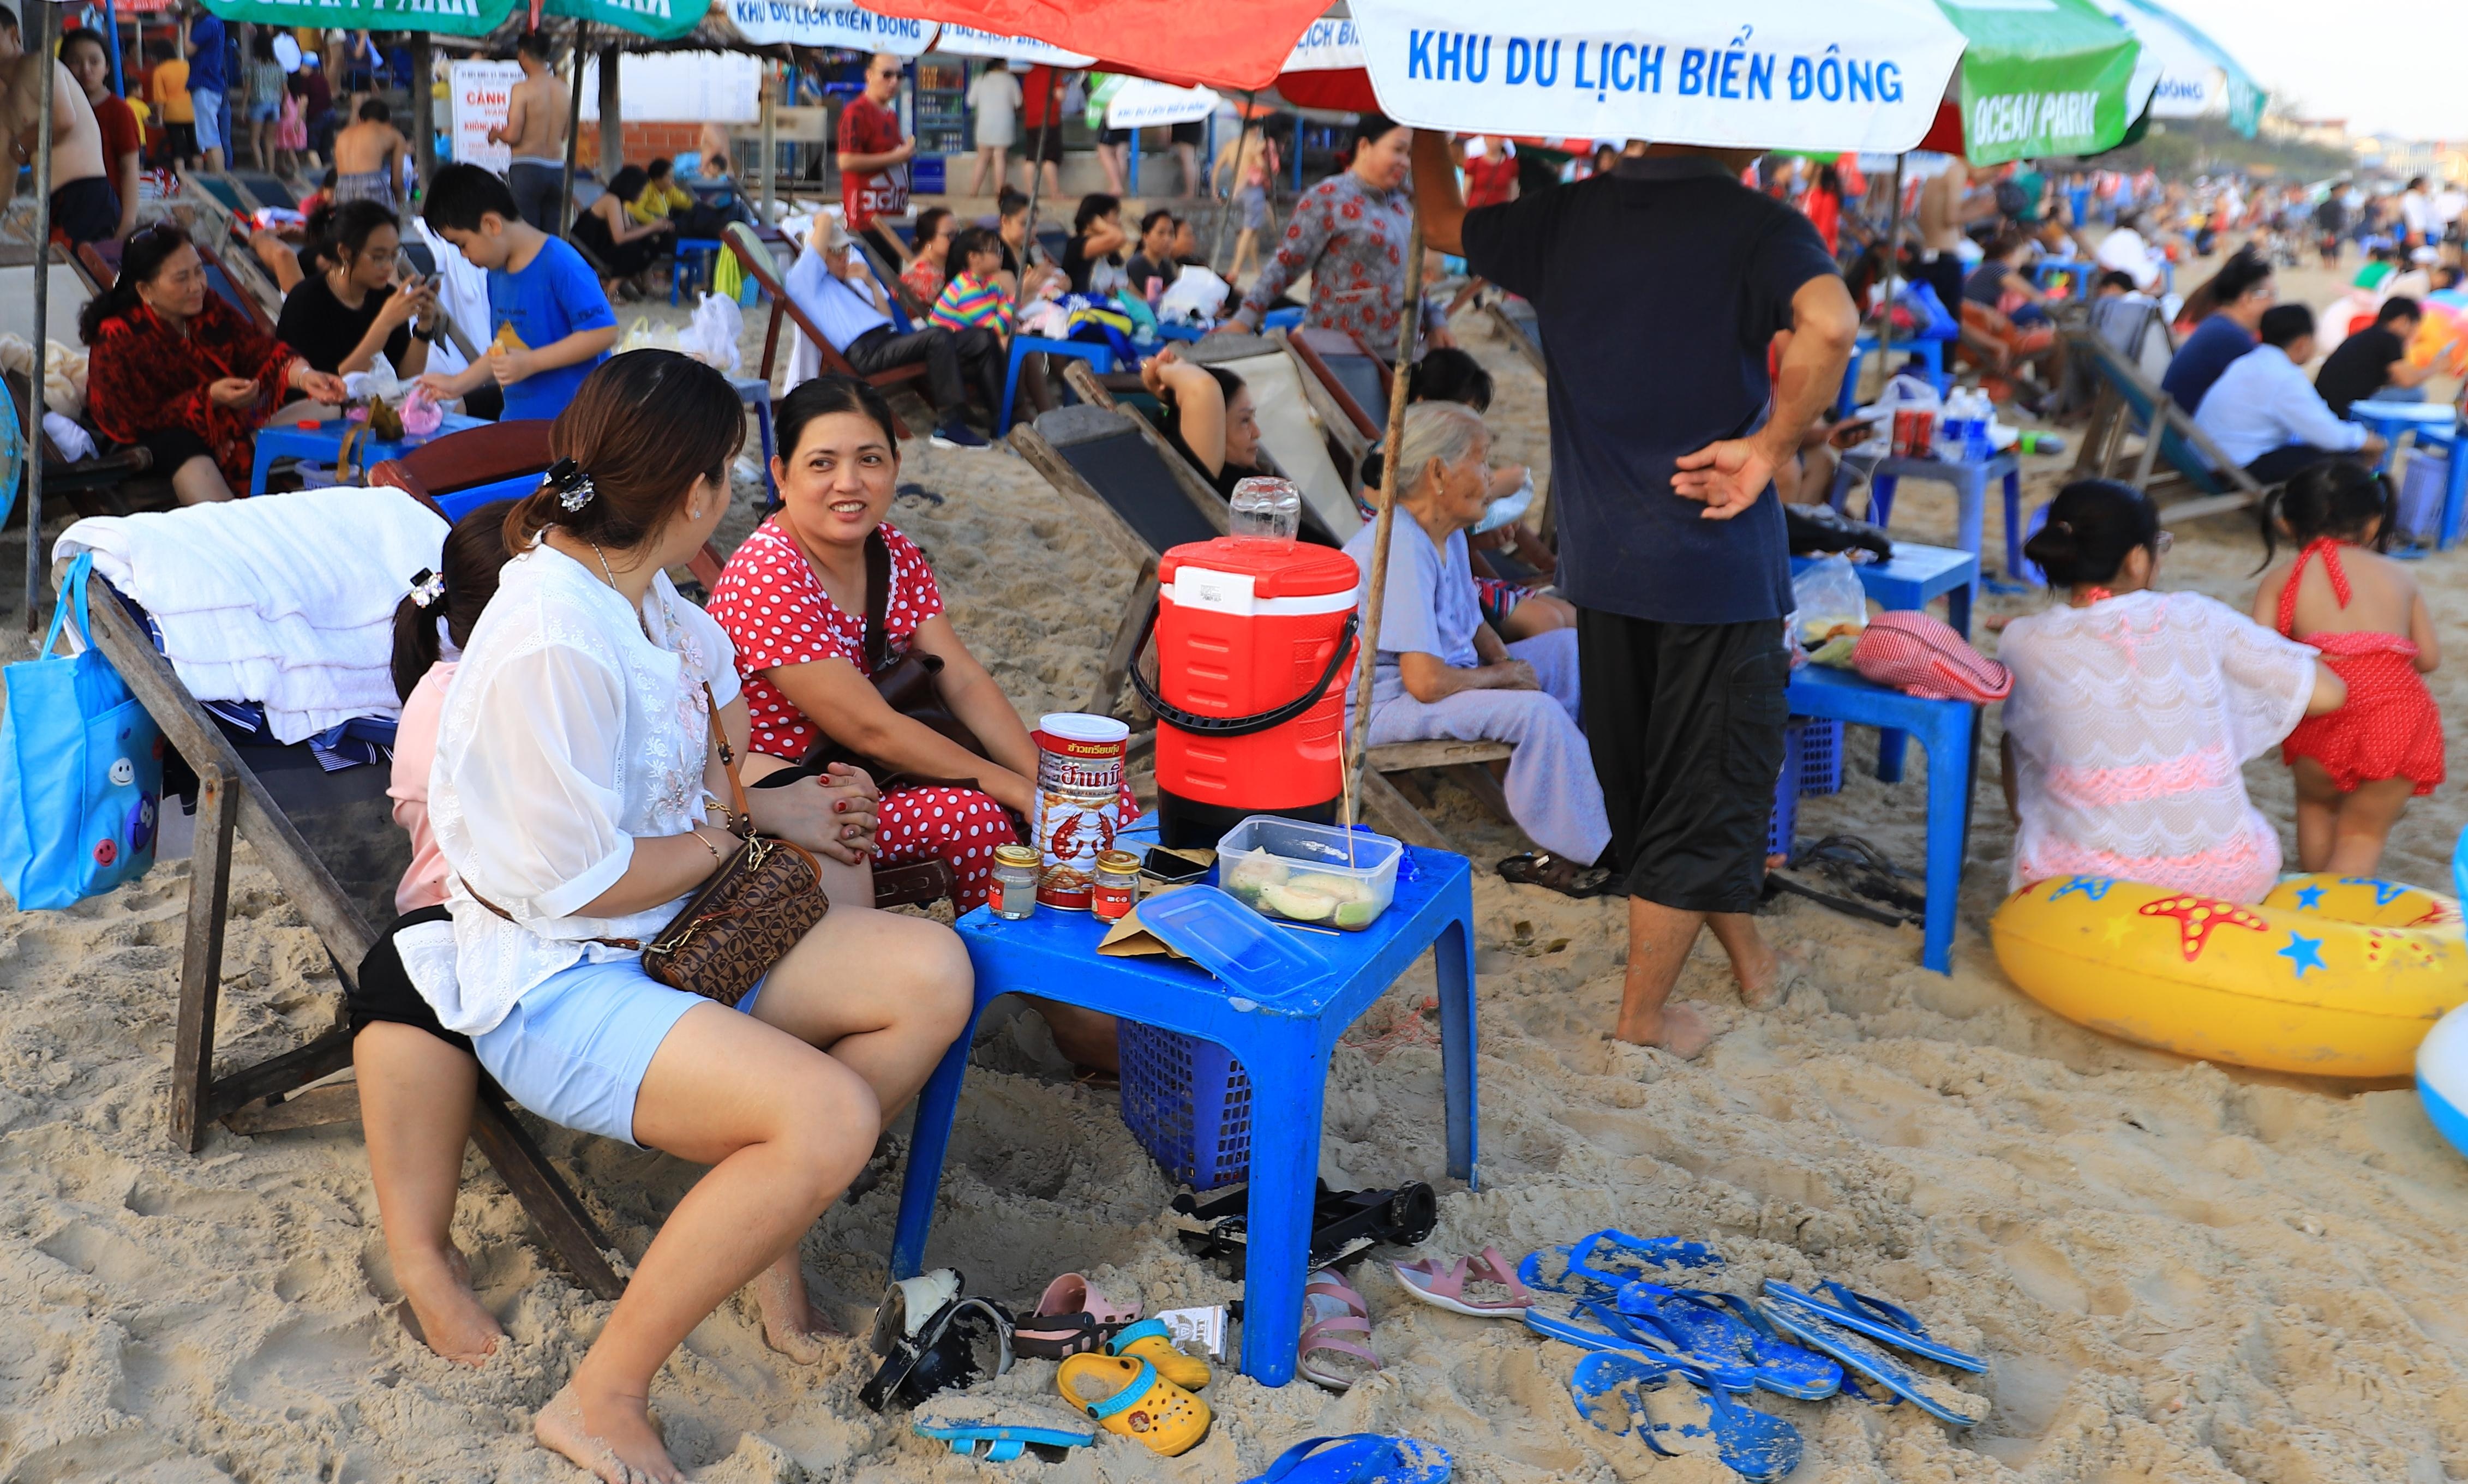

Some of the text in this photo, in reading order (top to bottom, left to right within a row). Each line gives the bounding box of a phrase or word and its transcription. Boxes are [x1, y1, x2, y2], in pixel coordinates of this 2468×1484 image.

[770, 2, 791, 22] DU
[1409, 23, 1904, 103] KHU DU LỊCH BIỂN ĐÔNG
[1974, 90, 2099, 146] OCEAN PARK
